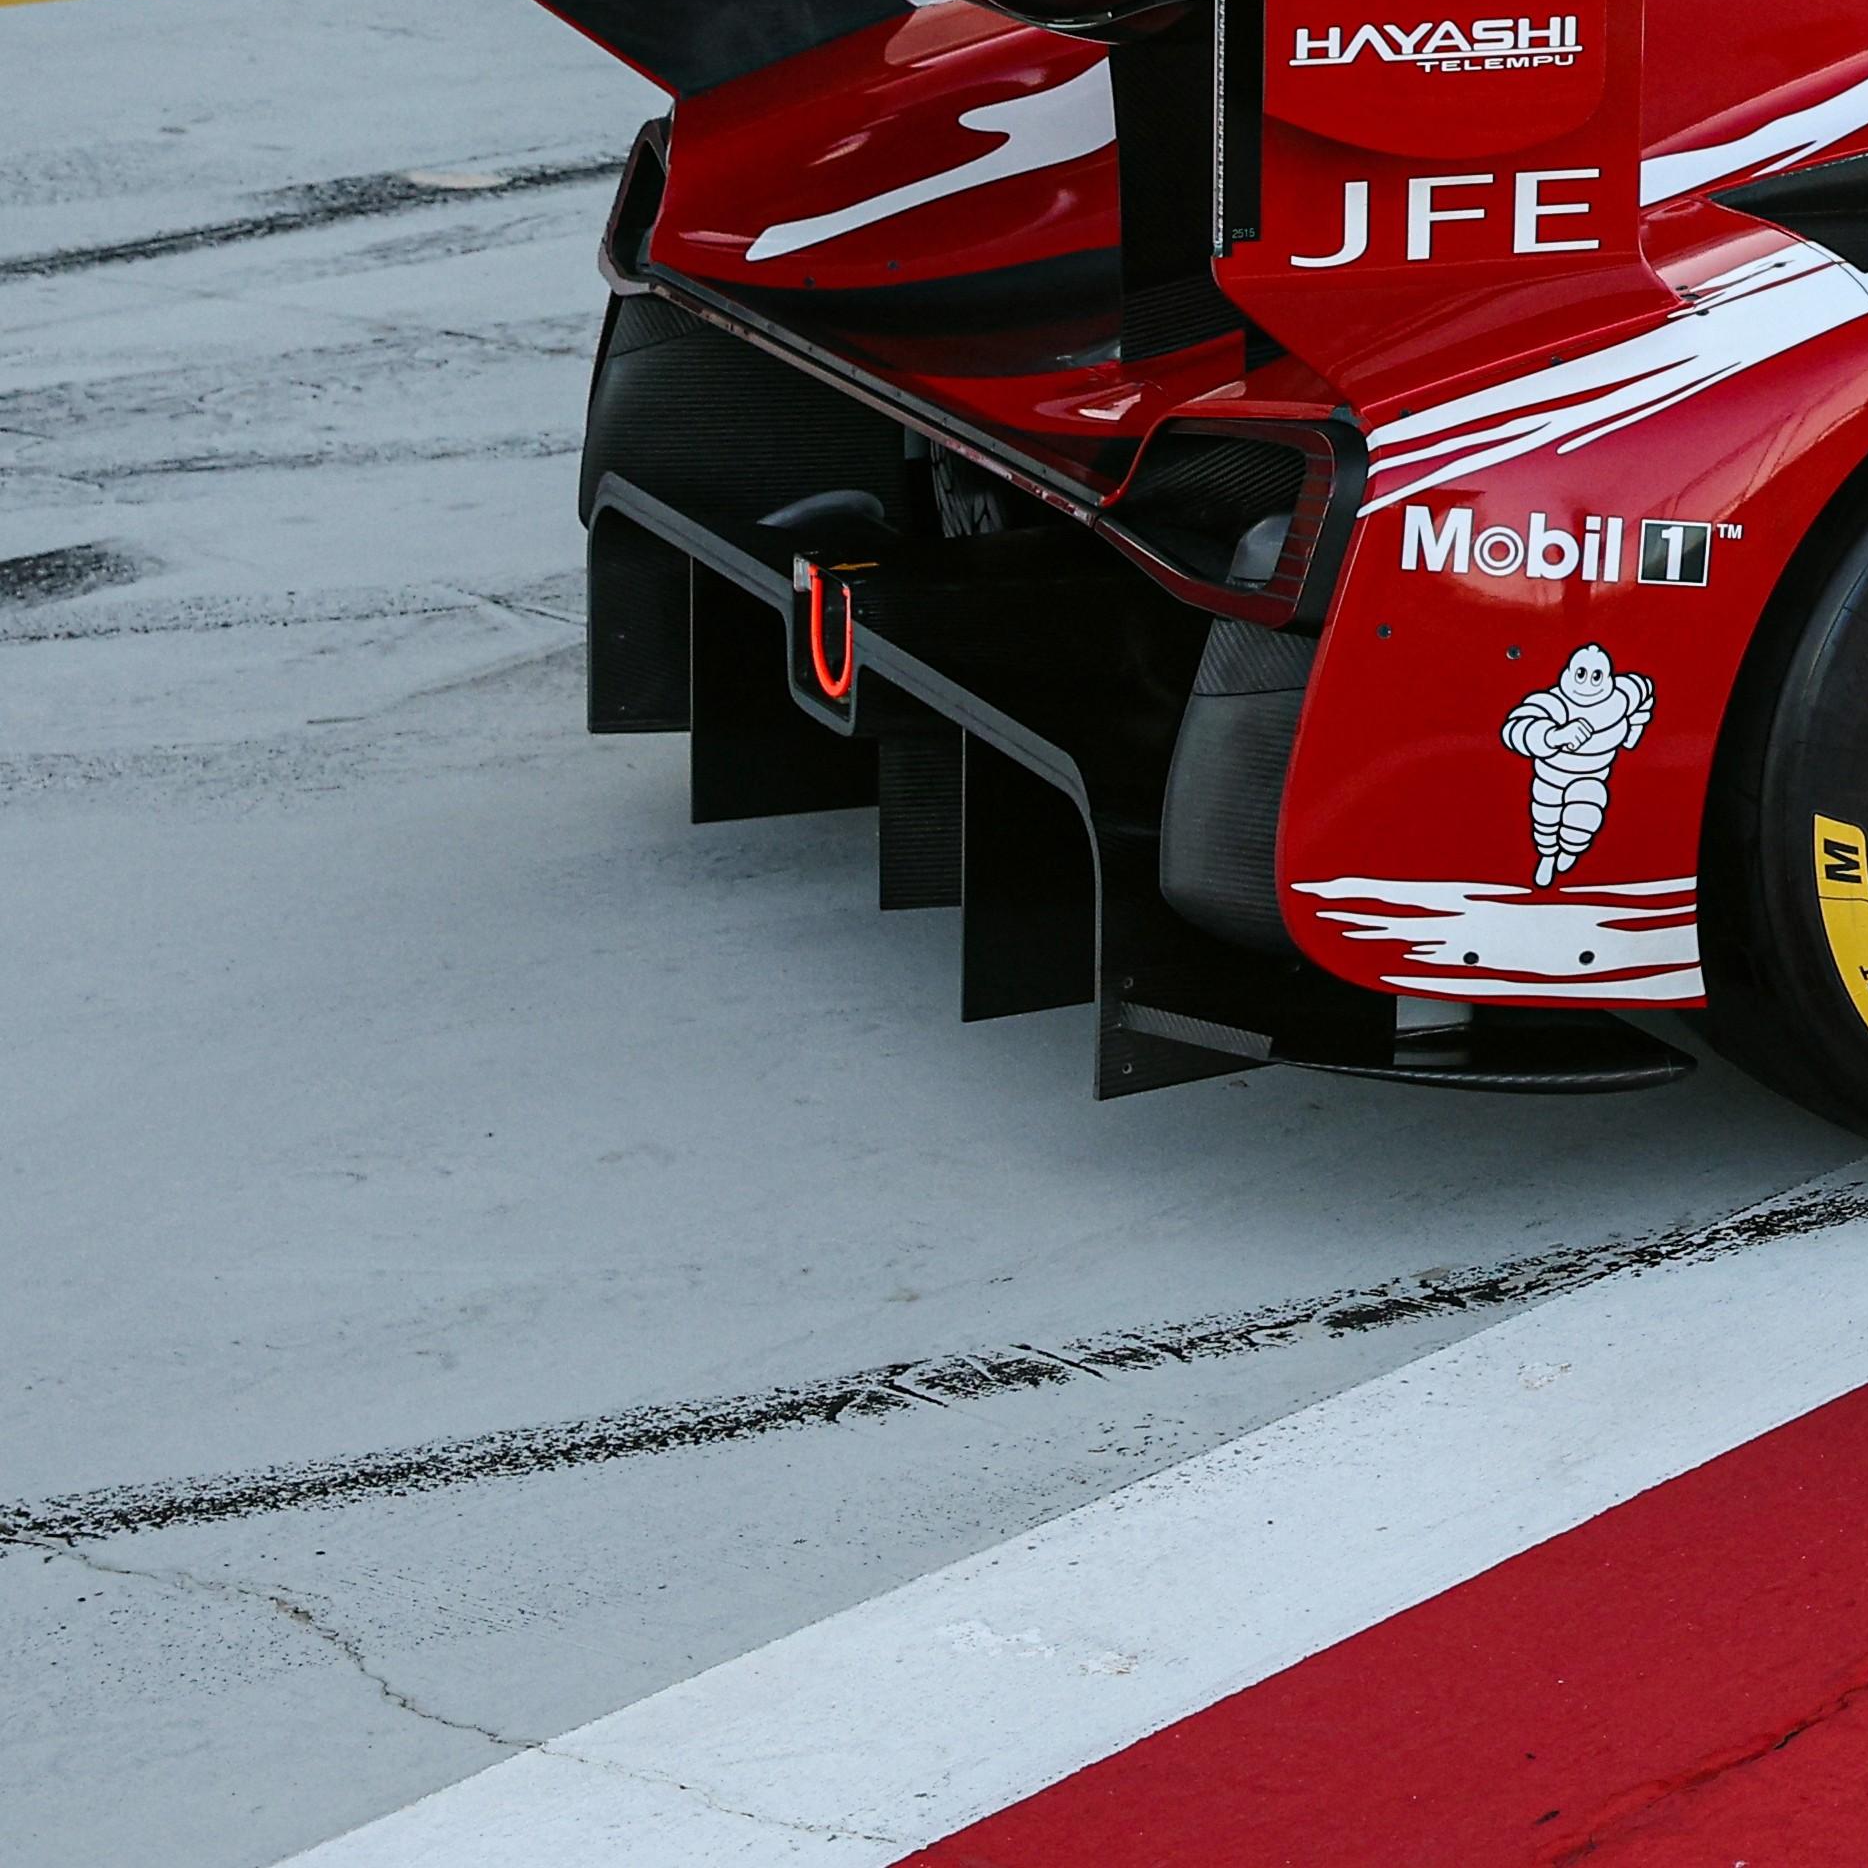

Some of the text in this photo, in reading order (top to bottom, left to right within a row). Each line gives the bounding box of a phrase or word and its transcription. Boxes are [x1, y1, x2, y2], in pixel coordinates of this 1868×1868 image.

[1289, 16, 1583, 66] HAYASHI
[1416, 54, 1575, 72] TELEMPU
[1289, 168, 1601, 268] JFE
[1400, 505, 1624, 583] Mobil
[1823, 838, 1862, 884] M
